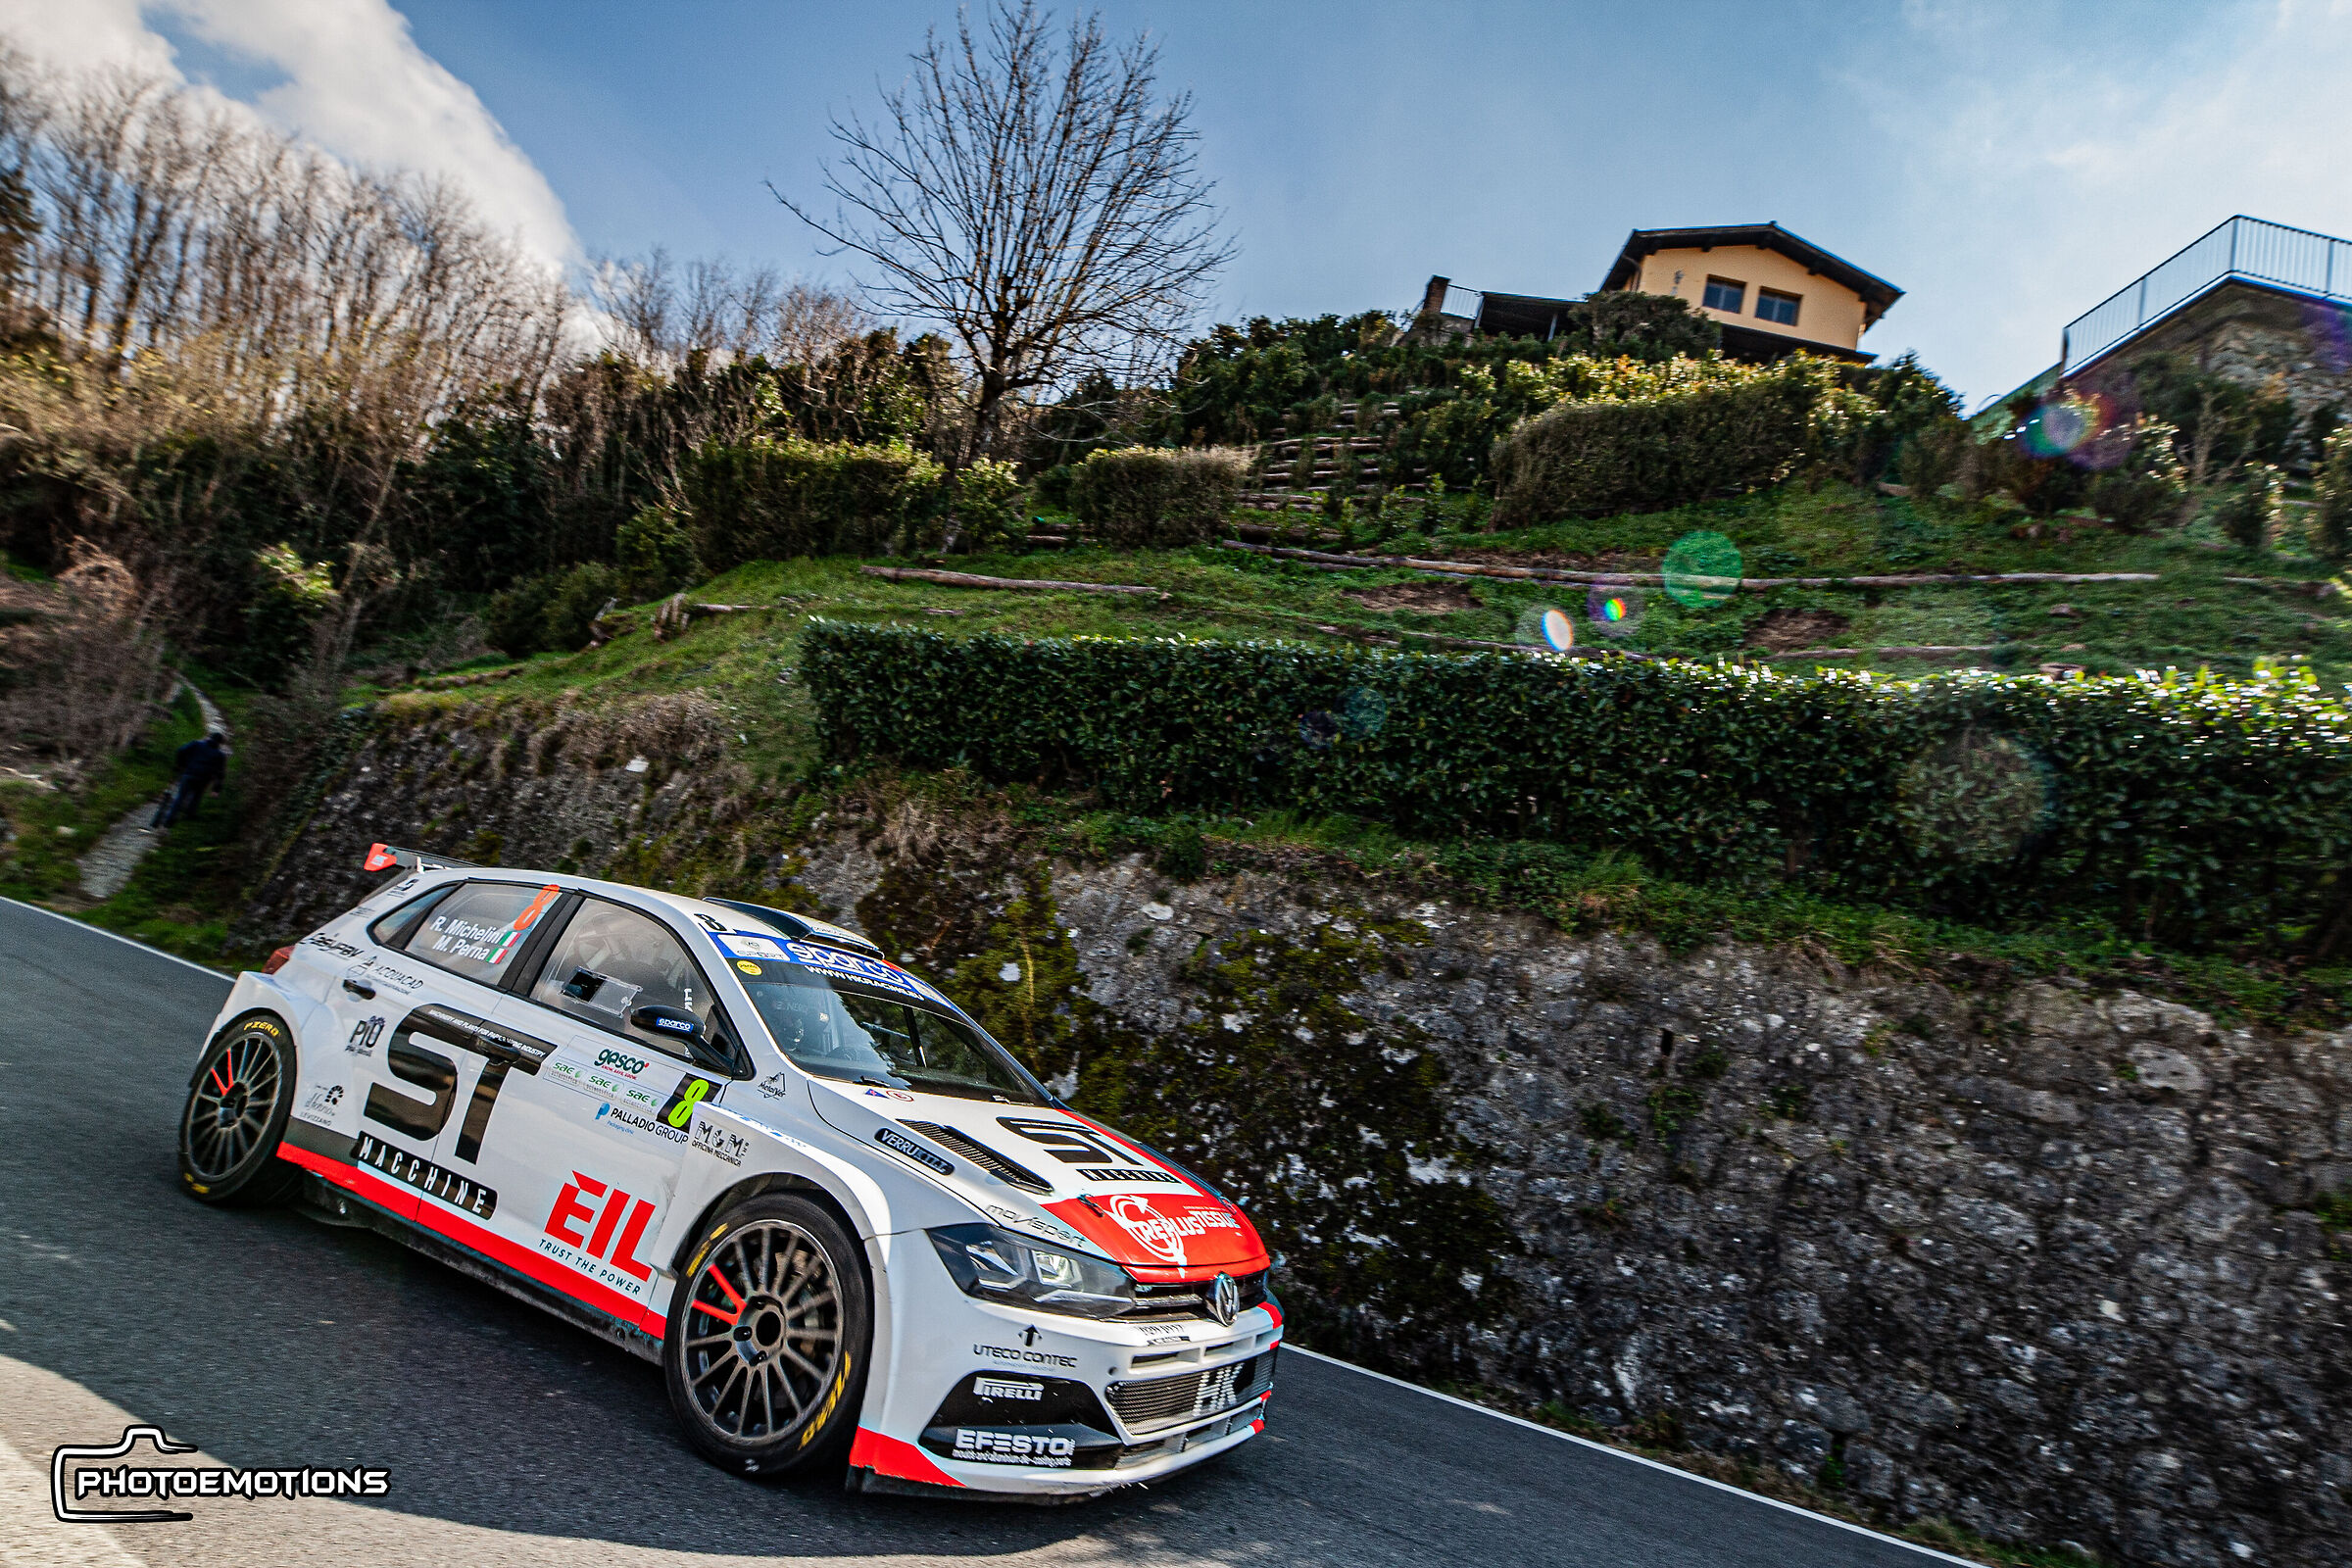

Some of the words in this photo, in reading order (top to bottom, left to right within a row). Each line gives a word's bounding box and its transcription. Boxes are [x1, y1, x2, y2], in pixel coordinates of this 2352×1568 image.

[514, 884, 560, 930] 8
[430, 916, 447, 932] R.
[445, 919, 507, 944] Michelini
[432, 935, 452, 952] M.
[450, 938, 490, 960] Perna
[786, 942, 910, 989] sparco
[659, 1017, 692, 1032] sparco
[363, 1003, 558, 1165] ST
[668, 1079, 710, 1128] 8
[611, 1108, 658, 1133] PALLADIO
[656, 1125, 689, 1145] GROUP
[691, 1141, 713, 1156] OFFICINA
[712, 1149, 742, 1167] MECCANICA
[359, 1136, 487, 1214] MACCHINE
[539, 1239, 572, 1261] TRUST
[575, 1256, 596, 1273] THE
[599, 1269, 641, 1295] POWER
[972, 1376, 1045, 1400] PIRELLI
[955, 1428, 1070, 1456] EFESTO
